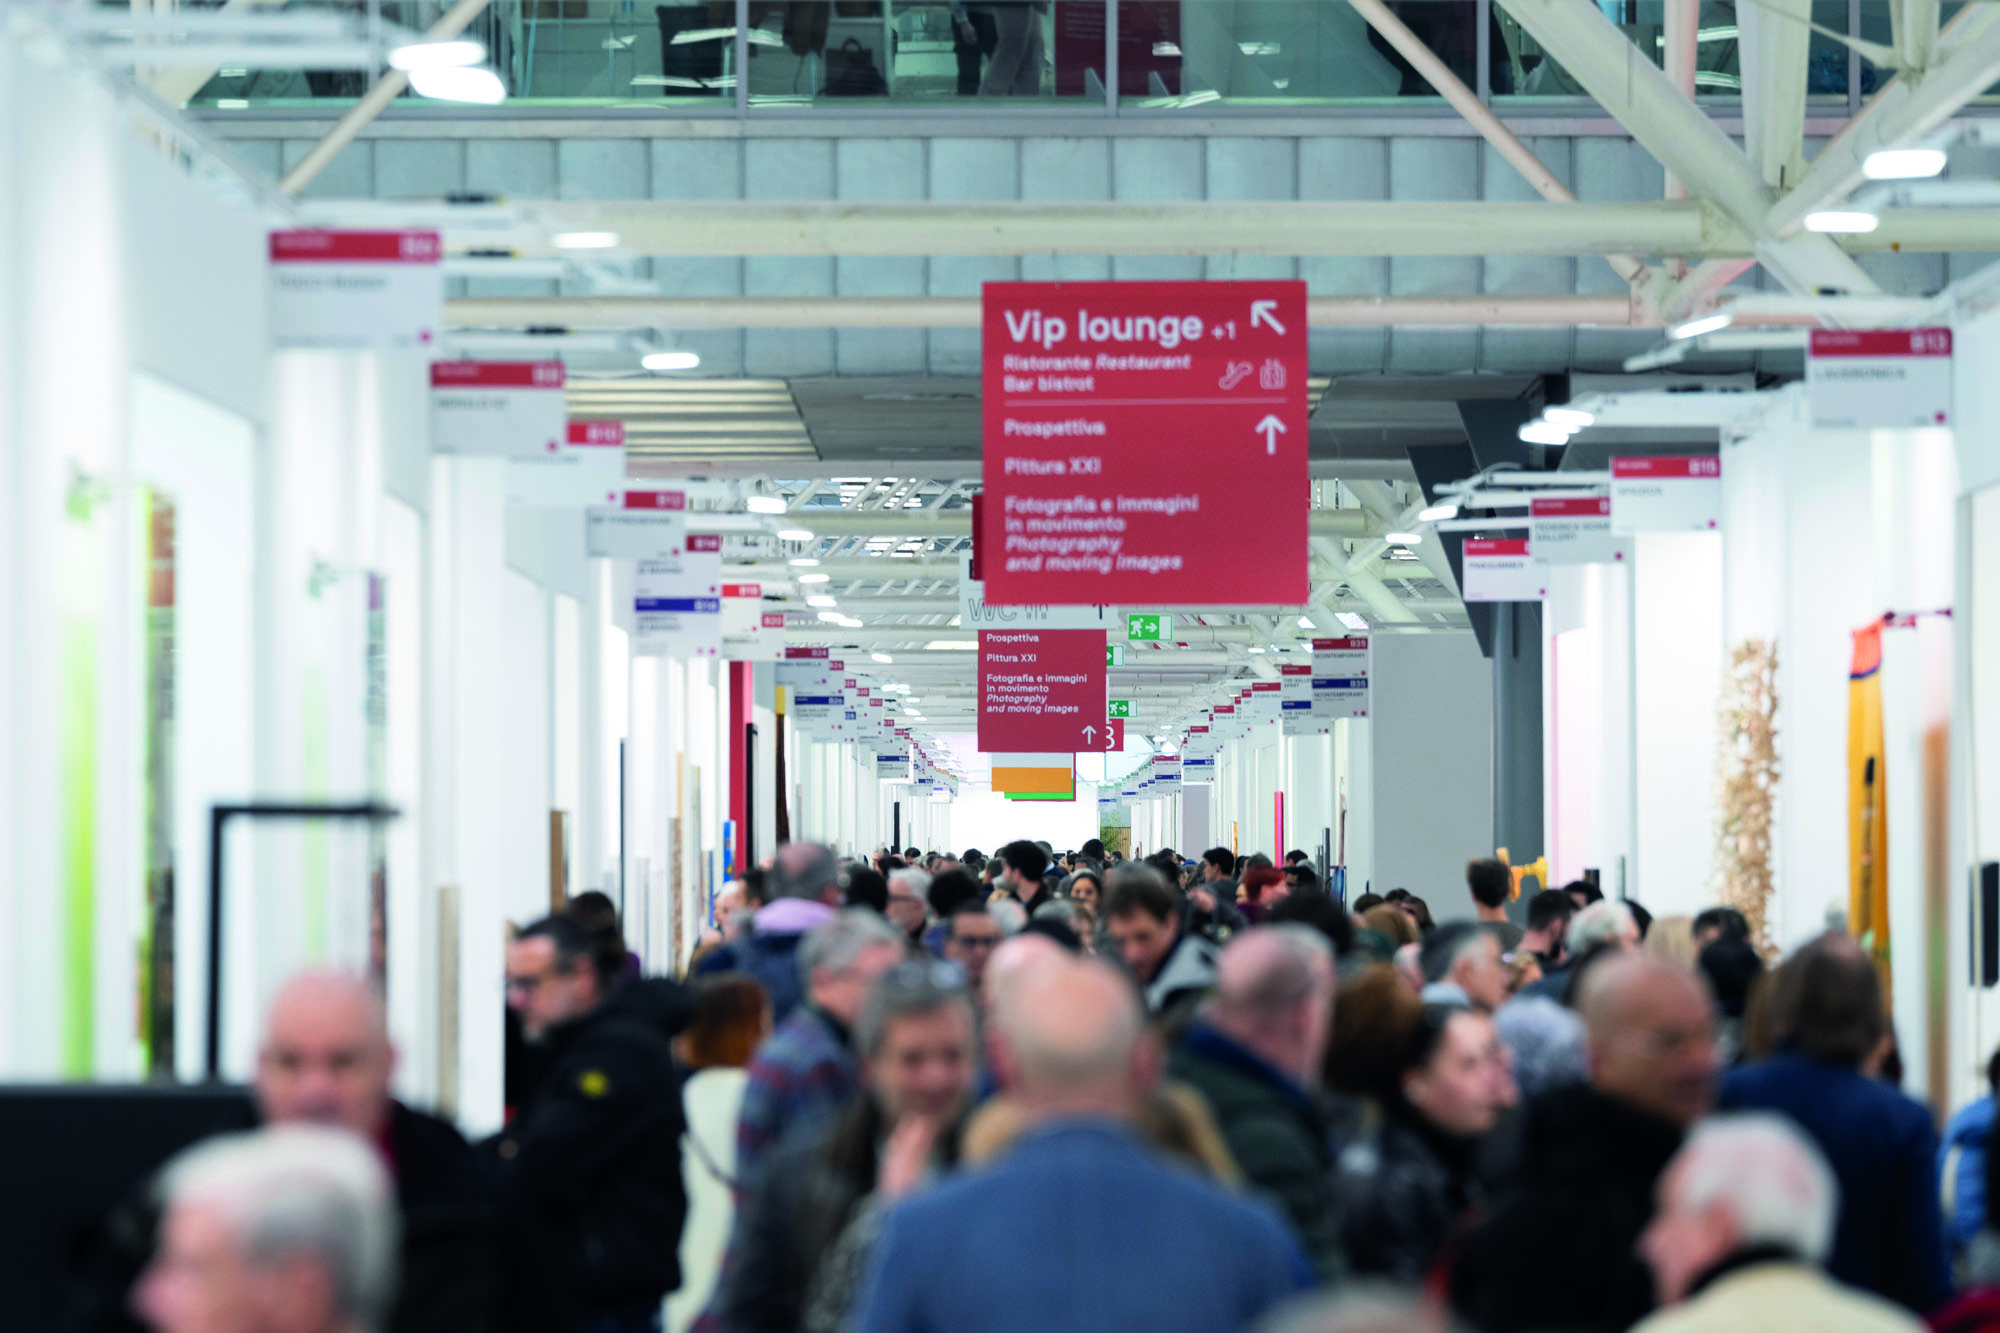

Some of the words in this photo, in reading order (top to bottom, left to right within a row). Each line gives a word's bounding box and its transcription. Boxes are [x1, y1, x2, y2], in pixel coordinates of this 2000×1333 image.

[1004, 309, 1067, 350] Vip
[1078, 308, 1203, 348] lounge
[1211, 321, 1237, 340] +1
[1003, 355, 1092, 371] Ristorante
[1095, 353, 1191, 370] Restaurant
[1003, 376, 1033, 392] Bar
[1038, 375, 1095, 392] bistrot
[1004, 418, 1106, 439] Prospettiva
[1004, 457, 1065, 475] Pittura
[1069, 457, 1102, 474] XXI
[1004, 495, 1097, 516] Fotografia
[1100, 498, 1113, 513] e
[1117, 494, 1200, 516] immagini
[1004, 516, 1023, 532] in
[1027, 516, 1126, 532] movimento
[1005, 535, 1123, 555] Photography
[1006, 554, 1042, 572] and
[1045, 555, 1112, 574] moving
[1116, 554, 1183, 574] images
[968, 598, 1018, 622] WC
[986, 633, 1040, 644] Prospettiva
[986, 653, 1019, 663] Pittura
[1020, 653, 1037, 663] XXI
[986, 673, 1035, 684] Fotografia
[1036, 675, 1043, 683] e
[1044, 673, 1088, 685] immagini
[986, 684, 996, 693] in
[997, 684, 1049, 693] movimento
[986, 694, 1048, 705] Photography
[986, 704, 1005, 713] and
[1007, 704, 1042, 715] moving
[1044, 704, 1079, 715] images
